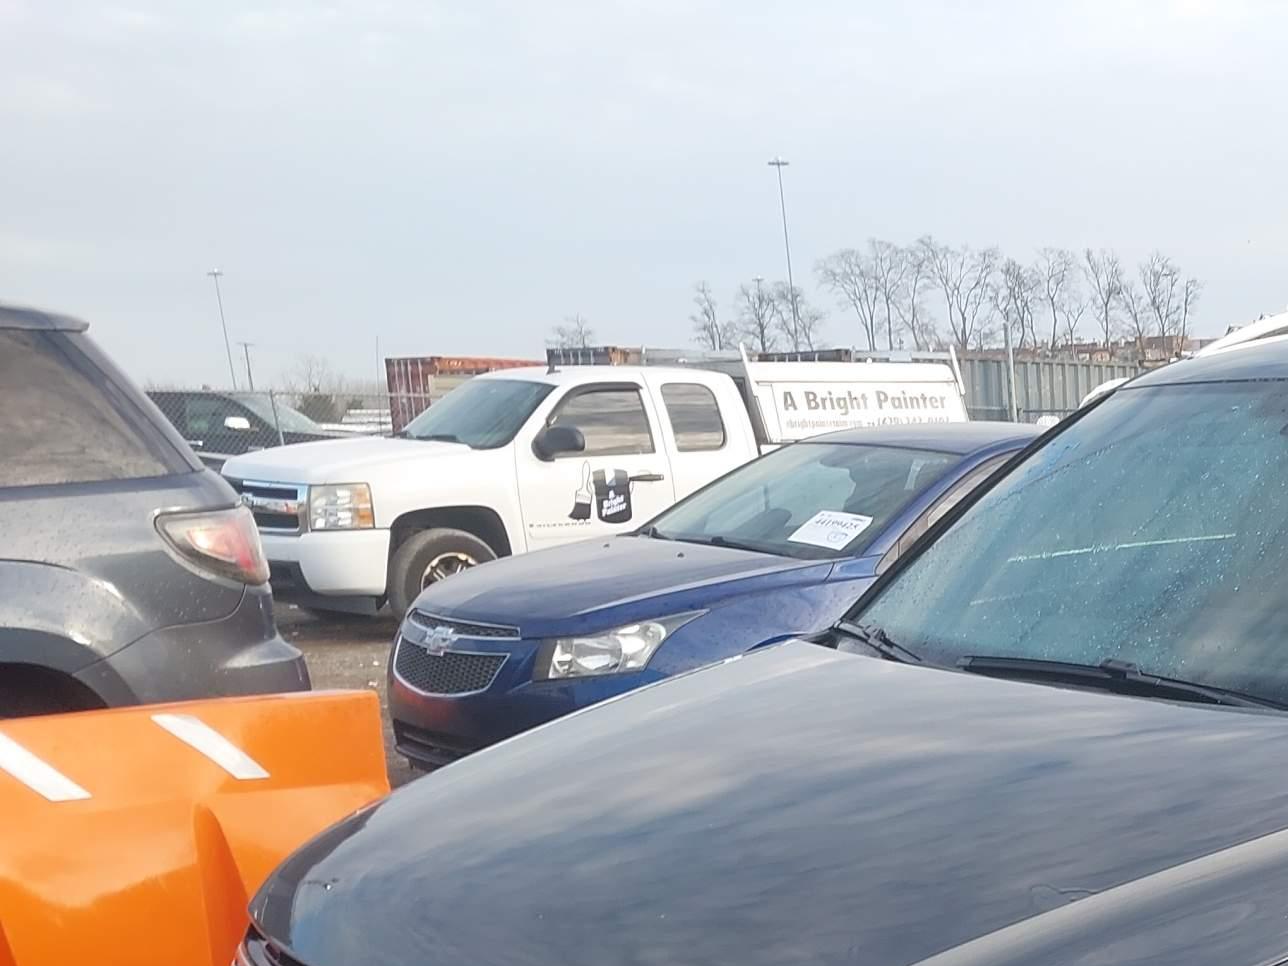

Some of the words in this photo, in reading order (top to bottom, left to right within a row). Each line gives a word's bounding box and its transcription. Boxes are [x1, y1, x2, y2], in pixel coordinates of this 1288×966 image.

[783, 391, 798, 411] A
[804, 390, 868, 416] Bright
[875, 390, 946, 410] Painter
